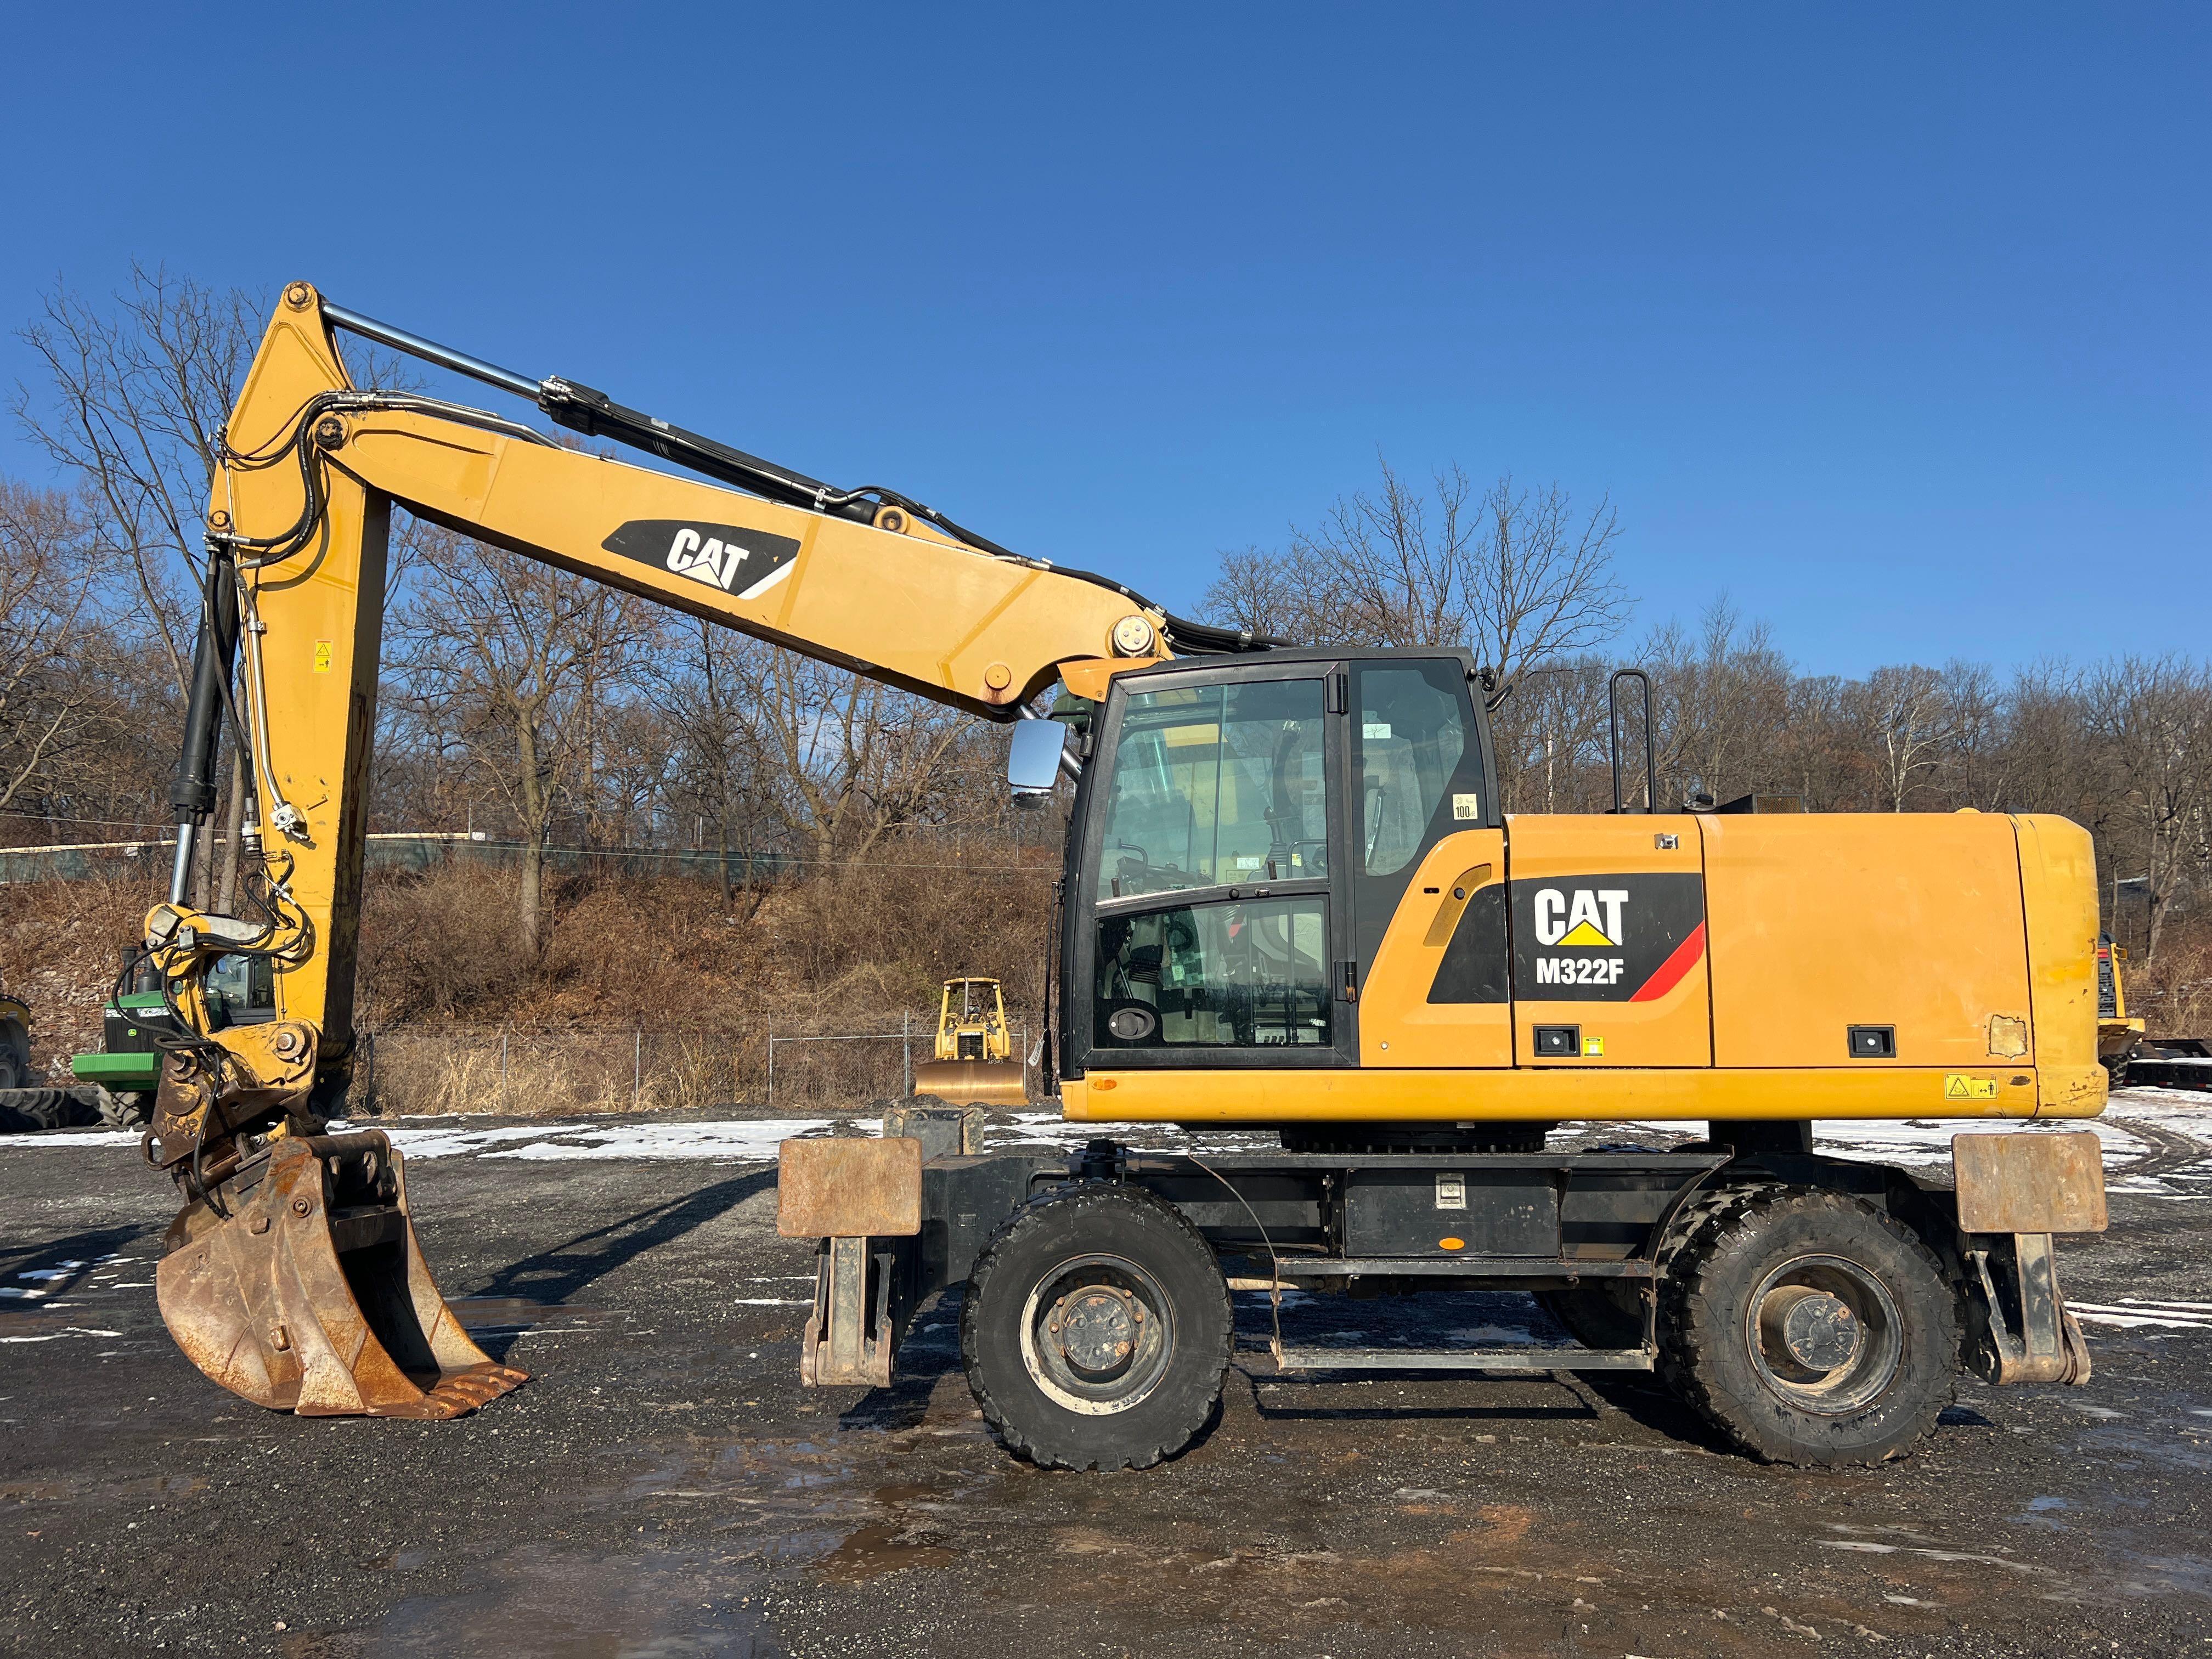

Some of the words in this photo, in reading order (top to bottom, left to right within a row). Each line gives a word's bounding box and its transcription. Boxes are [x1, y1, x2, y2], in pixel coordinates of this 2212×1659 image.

[666, 528, 750, 590] CAT
[1455, 806, 1470, 817] 100
[1534, 888, 1629, 946] CAT
[1536, 958, 1624, 984] M322F
